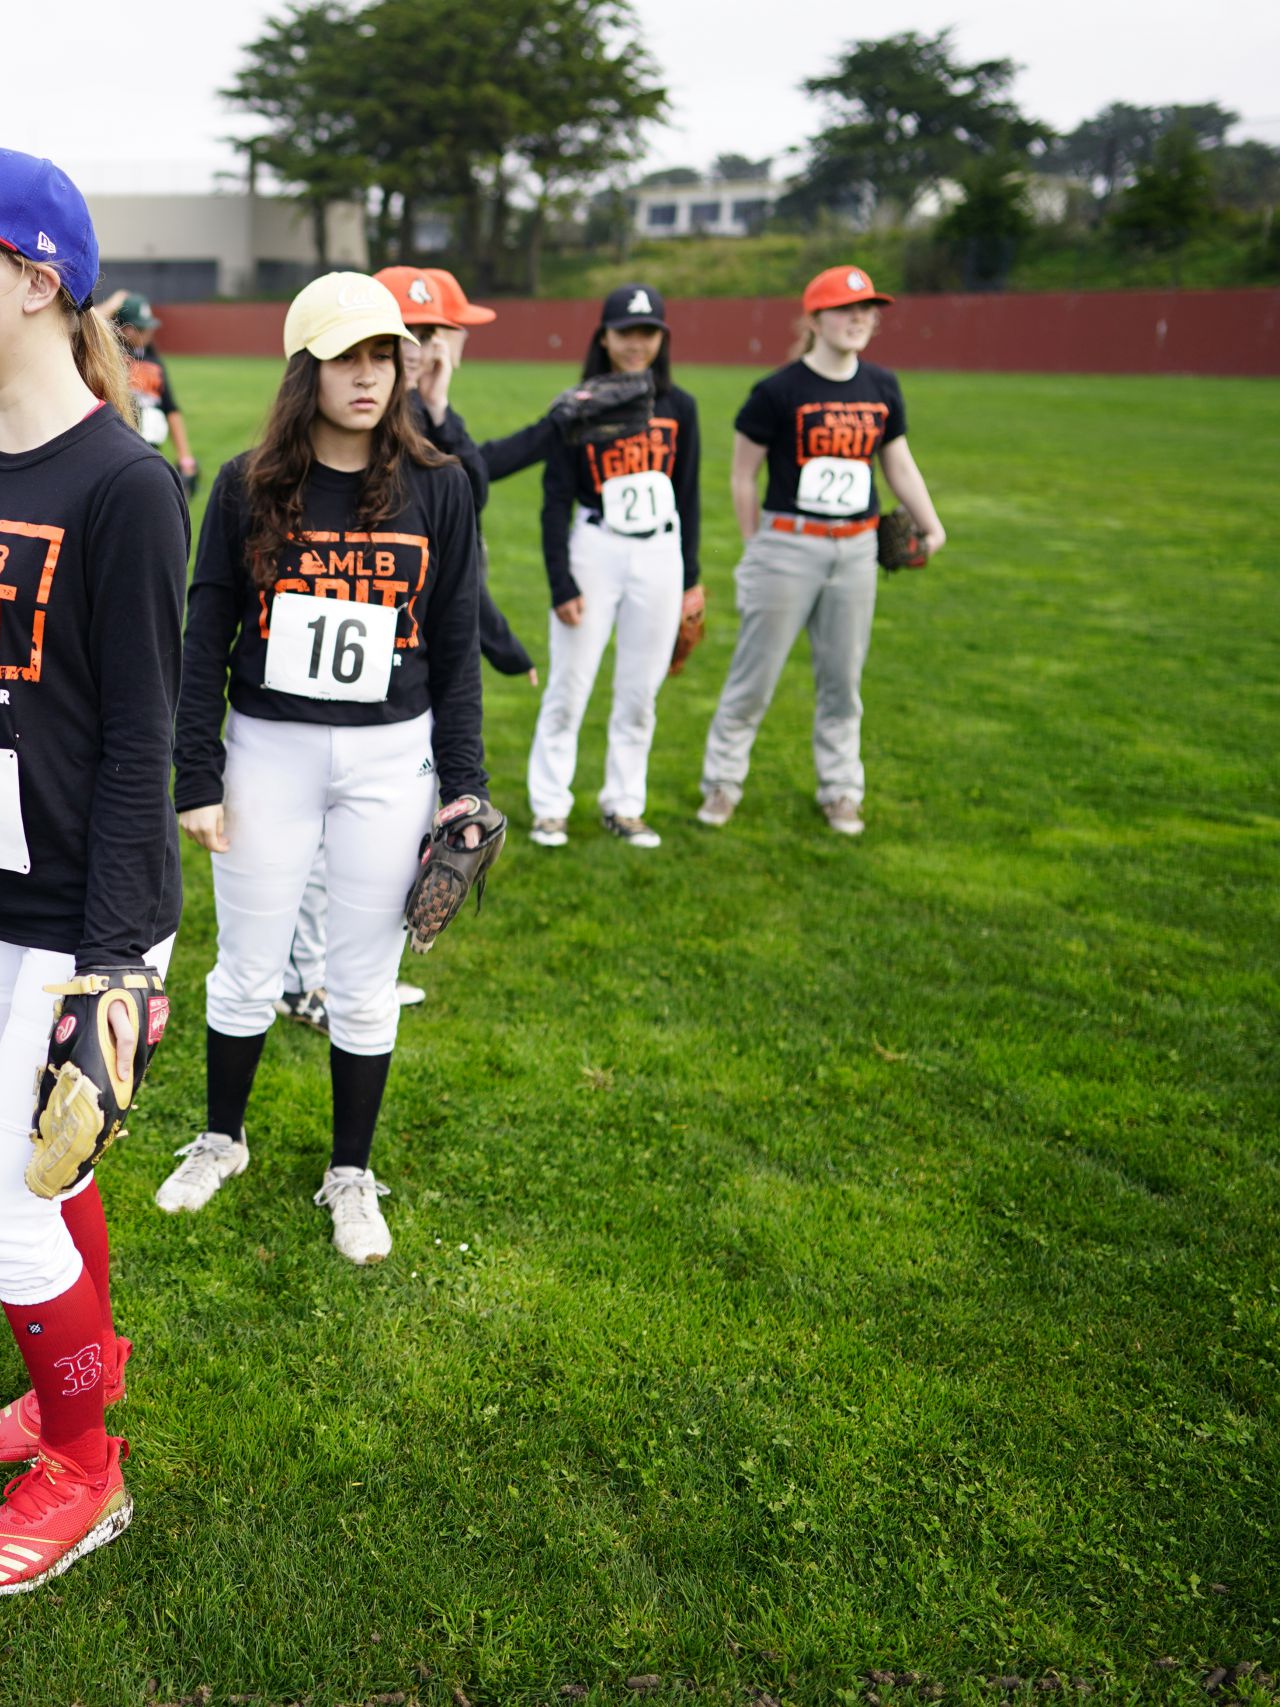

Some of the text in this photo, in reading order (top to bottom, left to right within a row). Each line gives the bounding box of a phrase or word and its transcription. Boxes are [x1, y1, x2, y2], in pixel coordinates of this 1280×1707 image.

[808, 425, 880, 457] GRIT
[602, 442, 670, 478] GRIT
[622, 486, 656, 521] 21
[817, 468, 854, 507] 22
[329, 550, 396, 577] MLB
[307, 615, 367, 684] 16
